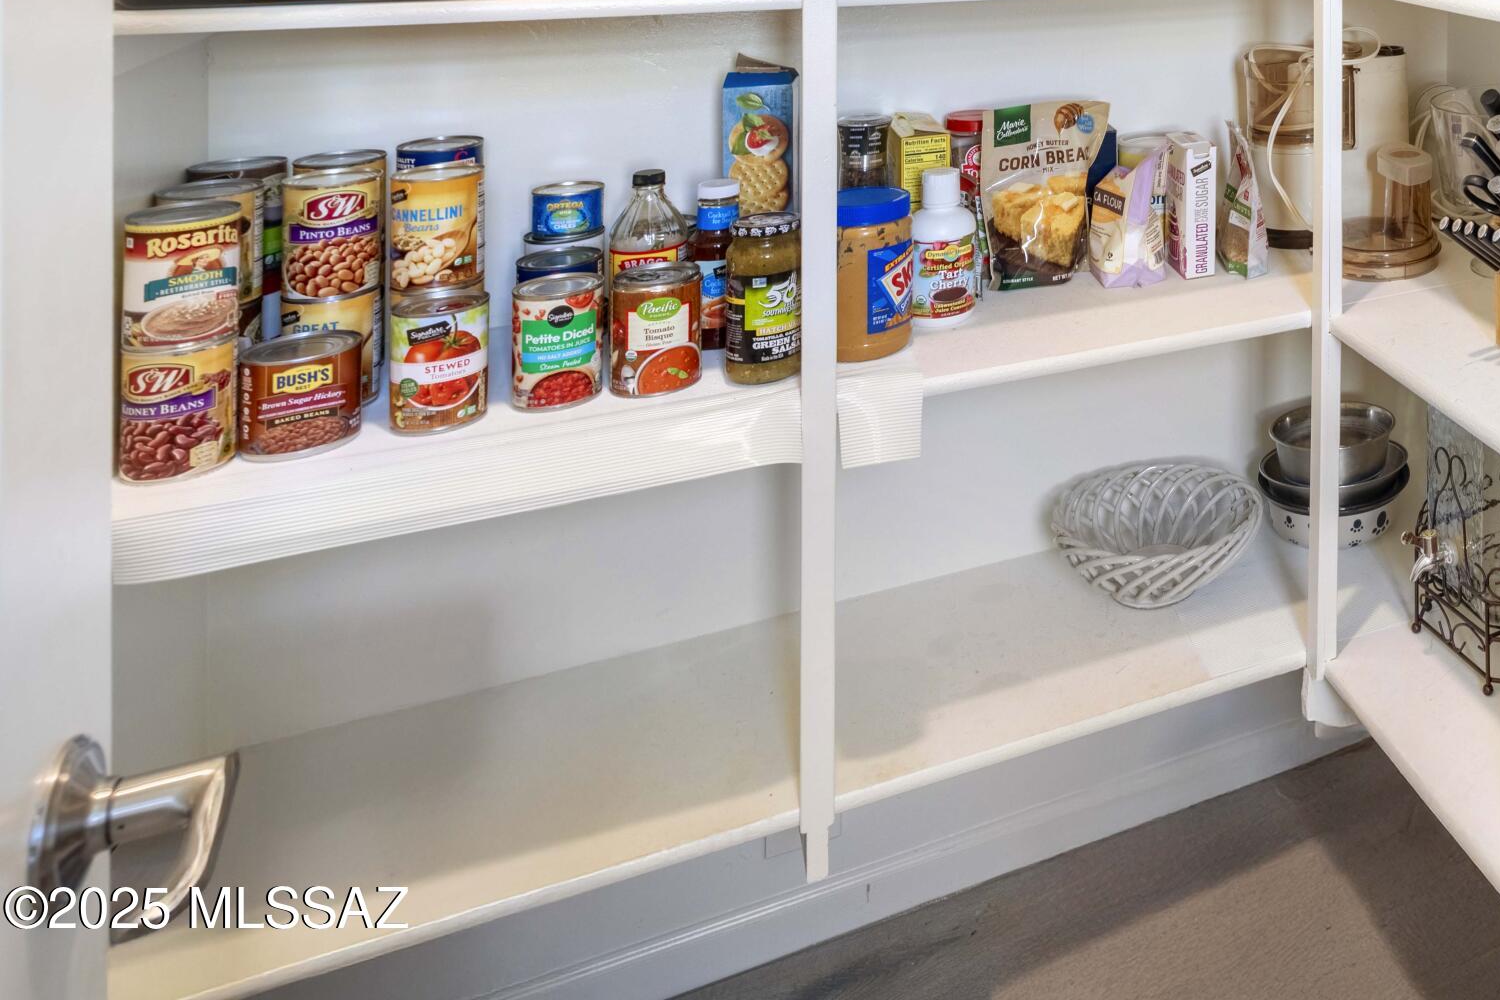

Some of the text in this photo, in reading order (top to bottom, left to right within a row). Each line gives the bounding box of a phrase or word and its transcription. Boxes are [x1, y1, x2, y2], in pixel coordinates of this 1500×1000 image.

[905, 139, 930, 147] Nutrition
[998, 154, 1040, 172] CORN
[547, 201, 584, 211] ORTEGA
[299, 222, 371, 240] PINTO BEANS
[1195, 177, 1209, 274] GRANULATED SUGAR
[146, 224, 239, 258] Rosarita
[168, 270, 223, 287] SMOOTH
[938, 268, 963, 280] Tart
[930, 278, 969, 291] Cherry
[640, 300, 678, 316] Pacific
[525, 324, 594, 345] Petite Diced
[644, 325, 675, 335] Tomato
[645, 332, 674, 342] Bisque
[752, 337, 791, 350] GREEN
[424, 358, 470, 374] STEWED
[276, 368, 330, 390] BUSH'S
[431, 369, 466, 380] Tomatoes
[160, 398, 205, 415] BEANS
[261, 390, 343, 412] Brown Sugar Hickory
[274, 409, 330, 425] BAKED BEANS
